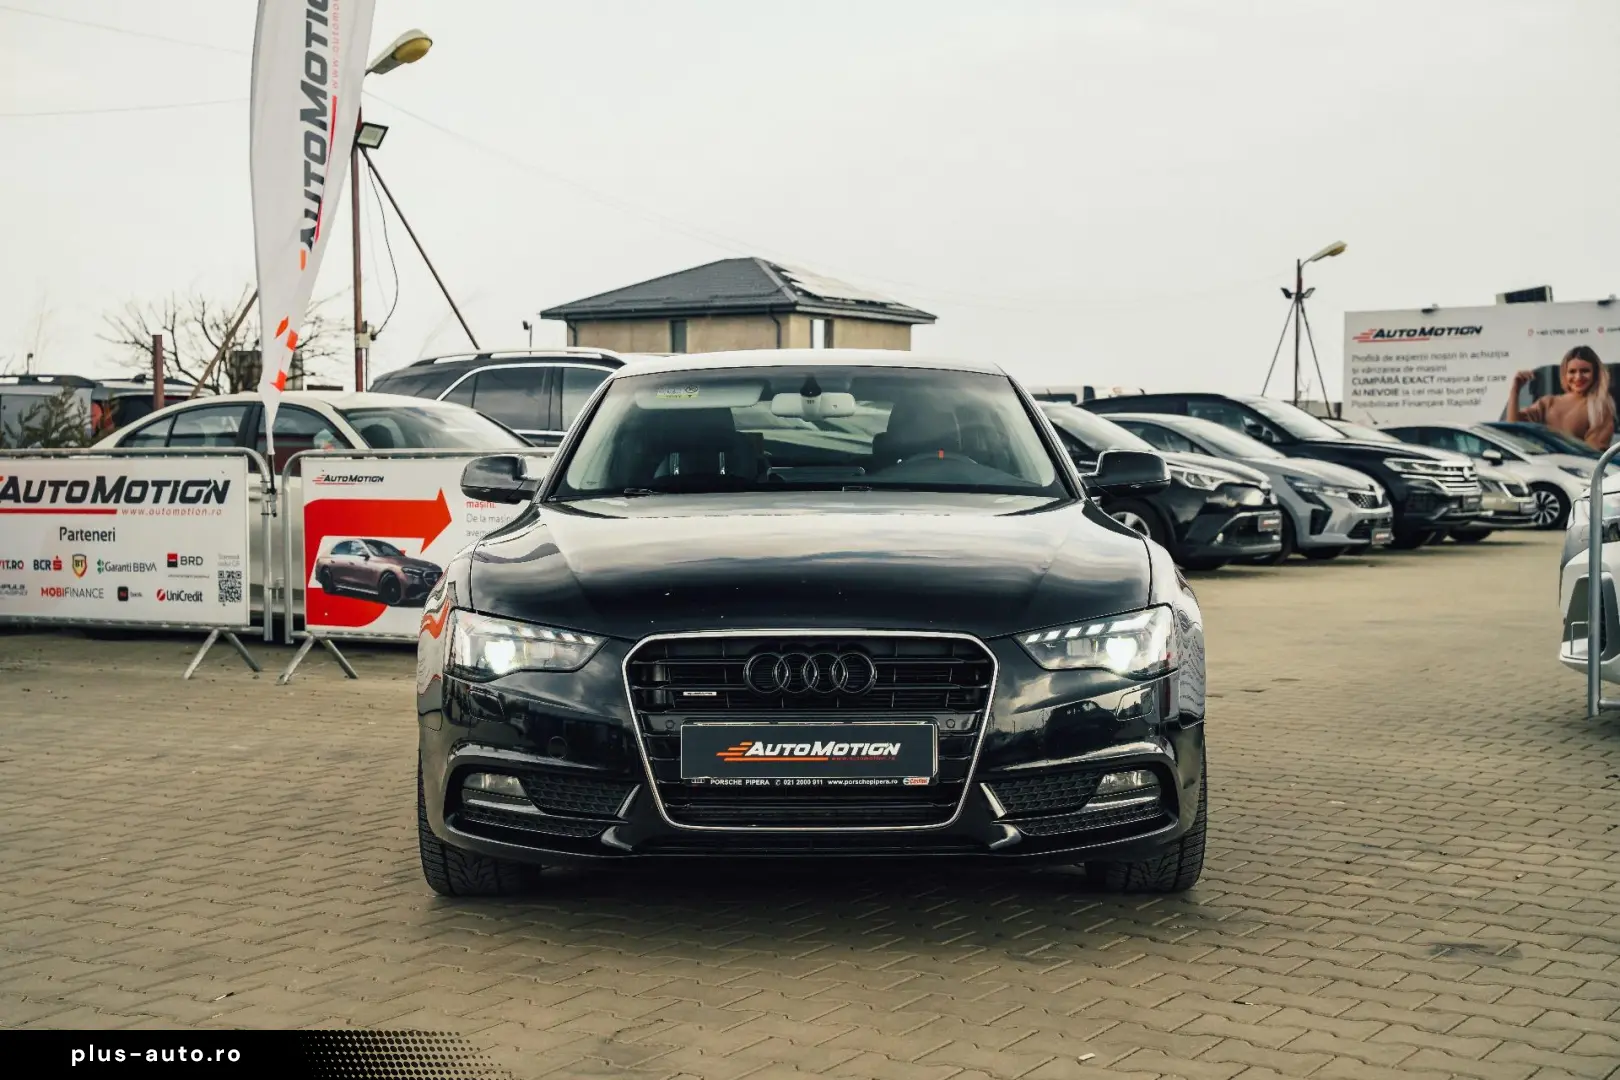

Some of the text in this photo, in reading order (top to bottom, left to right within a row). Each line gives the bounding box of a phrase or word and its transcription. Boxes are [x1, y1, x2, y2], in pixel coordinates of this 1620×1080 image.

[332, 0, 341, 89] www.automo
[1372, 325, 1483, 338] AUTOMOTION
[1402, 375, 1434, 385] EXACT
[1363, 388, 1399, 397] NEVOIE
[323, 474, 385, 483] AUTOMOTION
[0, 476, 231, 504] AUTOMOTION
[121, 508, 223, 516] www.automotion.ro
[59, 526, 116, 543] Parteneri
[33, 559, 52, 571] BCR
[104, 561, 132, 573] Garanti
[133, 562, 158, 573] BBVA
[180, 555, 204, 566] BRD
[40, 587, 105, 599] MOBIFINANCE
[166, 589, 204, 602] UniCredit
[744, 741, 901, 756] AUTOMOTION
[827, 778, 898, 786] www.porschepipera.ro
